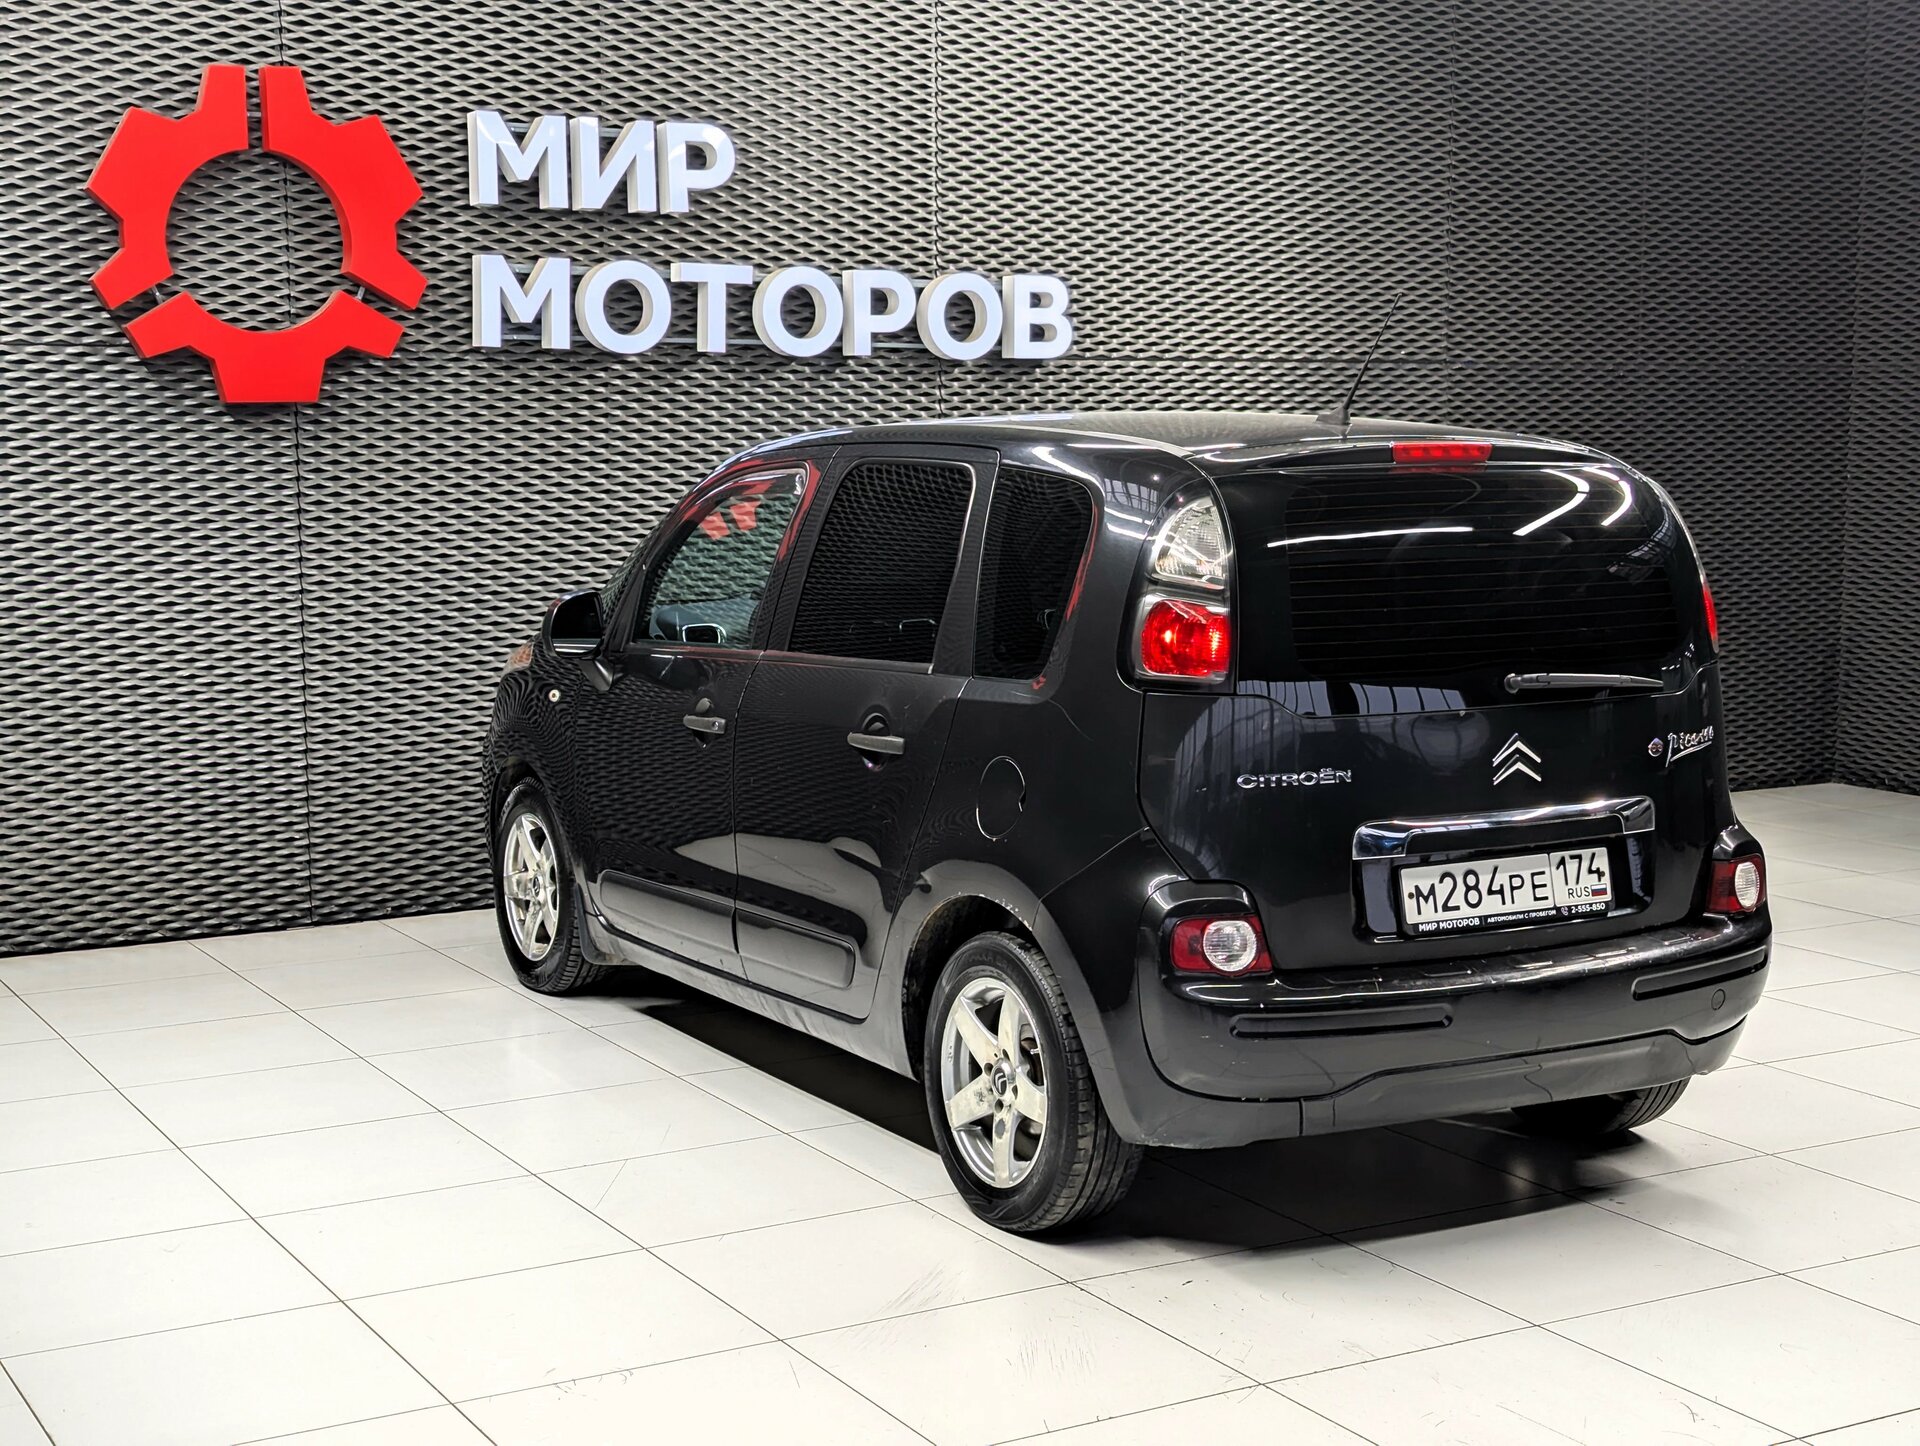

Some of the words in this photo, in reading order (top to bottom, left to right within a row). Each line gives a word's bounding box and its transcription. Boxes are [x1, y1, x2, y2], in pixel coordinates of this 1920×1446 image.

[467, 111, 736, 215] МИР
[472, 254, 1074, 361] МОТОРОВ
[1236, 767, 1352, 789] CITROËN
[1555, 852, 1602, 886] 174
[1567, 886, 1591, 899] RUS
[1487, 913, 1524, 923] АВТОМОБИЛИ
[1529, 909, 1557, 918] ПРОБЕГОМ
[1571, 903, 1606, 914] 2-555-850
[1418, 922, 1438, 932] МИР
[1439, 917, 1480, 929] МОТОРОВ
